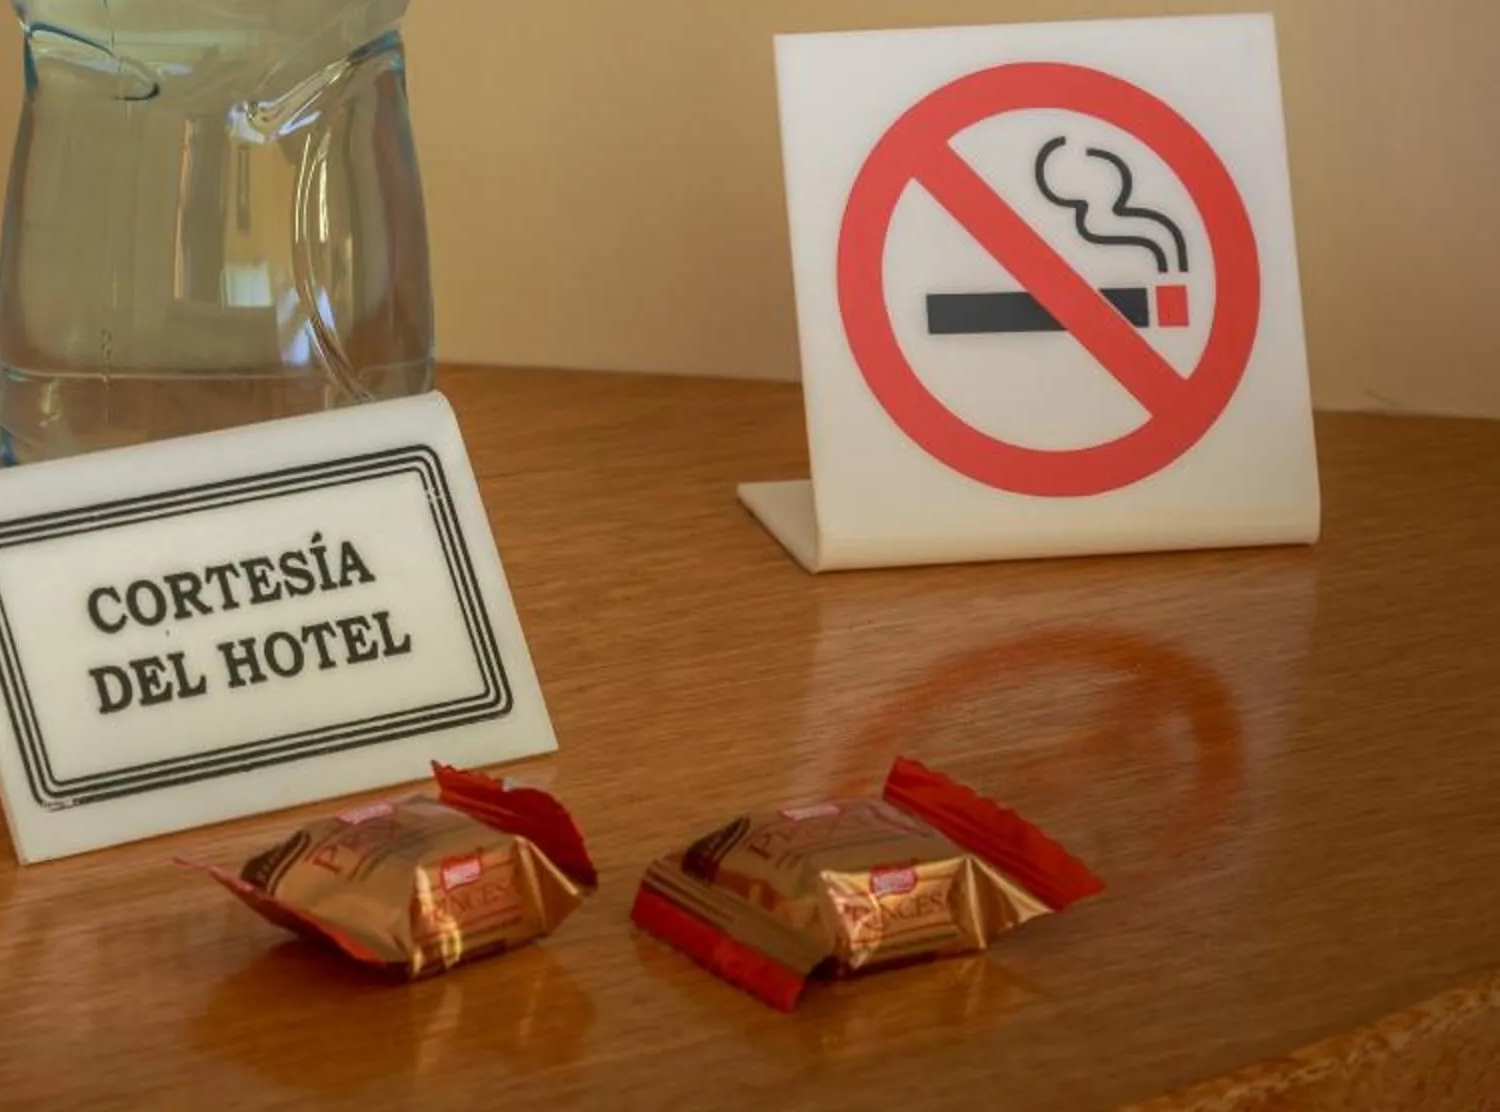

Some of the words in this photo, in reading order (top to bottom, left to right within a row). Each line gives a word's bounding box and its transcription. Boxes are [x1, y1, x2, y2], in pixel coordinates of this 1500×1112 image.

[87, 531, 376, 634] CORTESÍA
[88, 651, 207, 715] DEL
[217, 611, 412, 689] HOTEL
